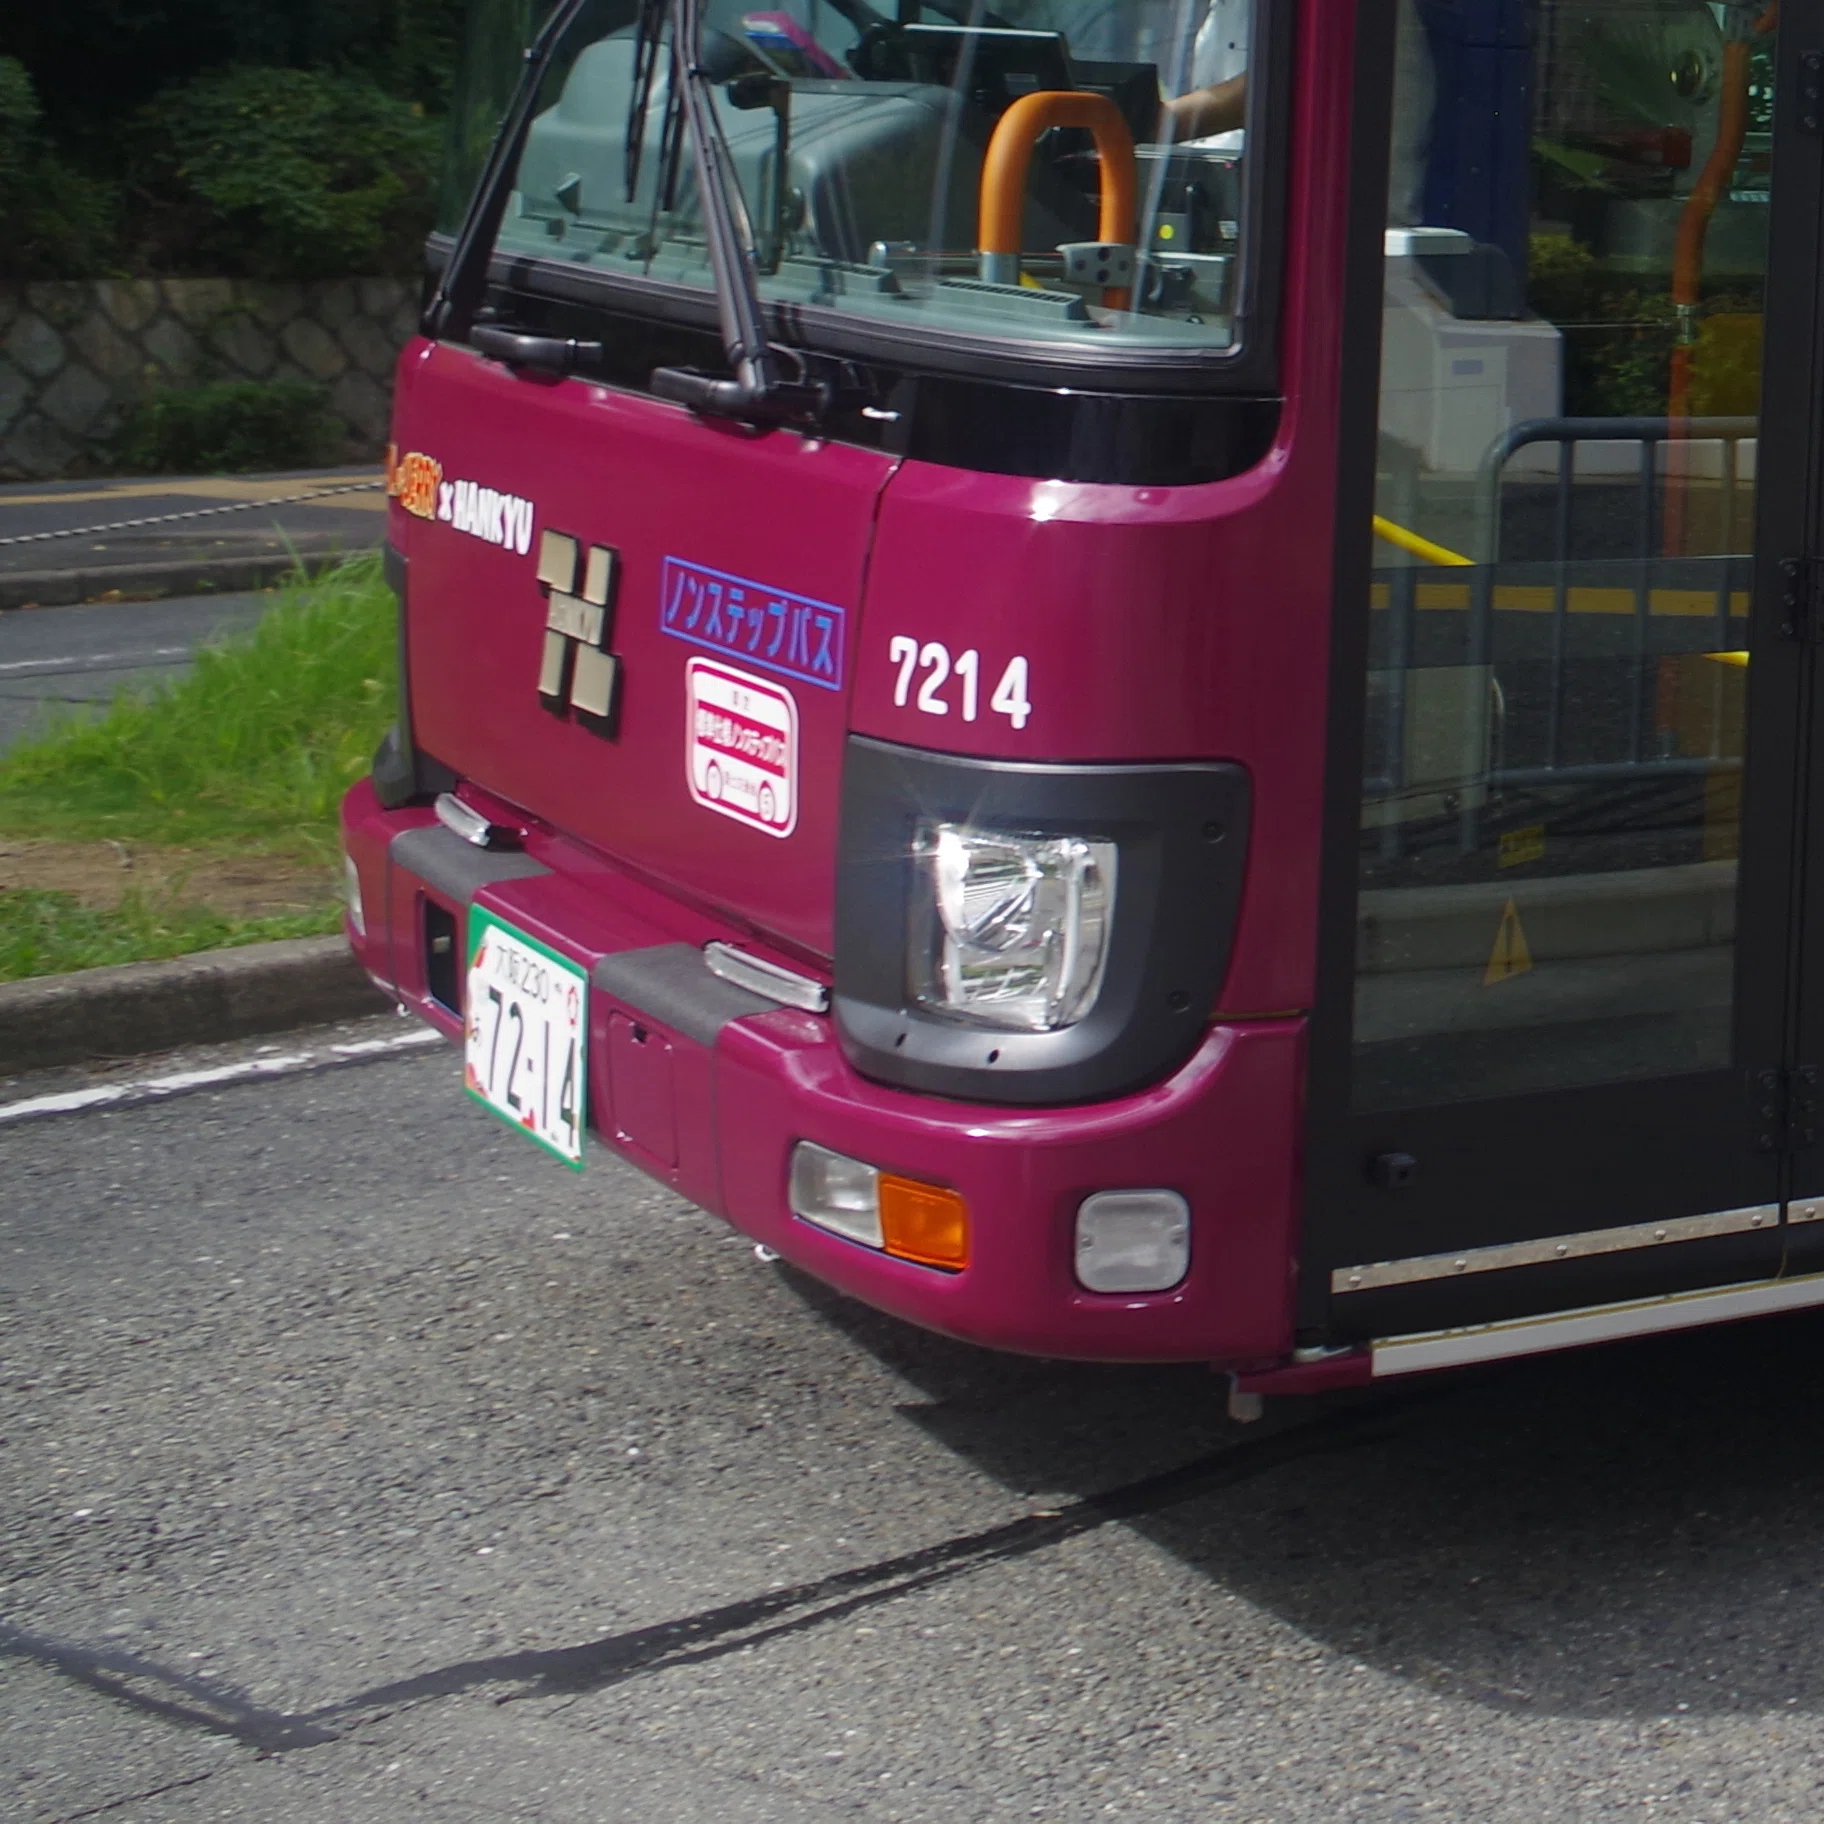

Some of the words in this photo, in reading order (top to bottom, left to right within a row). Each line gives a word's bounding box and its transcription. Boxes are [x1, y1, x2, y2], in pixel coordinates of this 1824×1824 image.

[452, 480, 534, 556] HANKYU
[665, 571, 834, 674] ノンステップバス
[888, 635, 1032, 729] 7214
